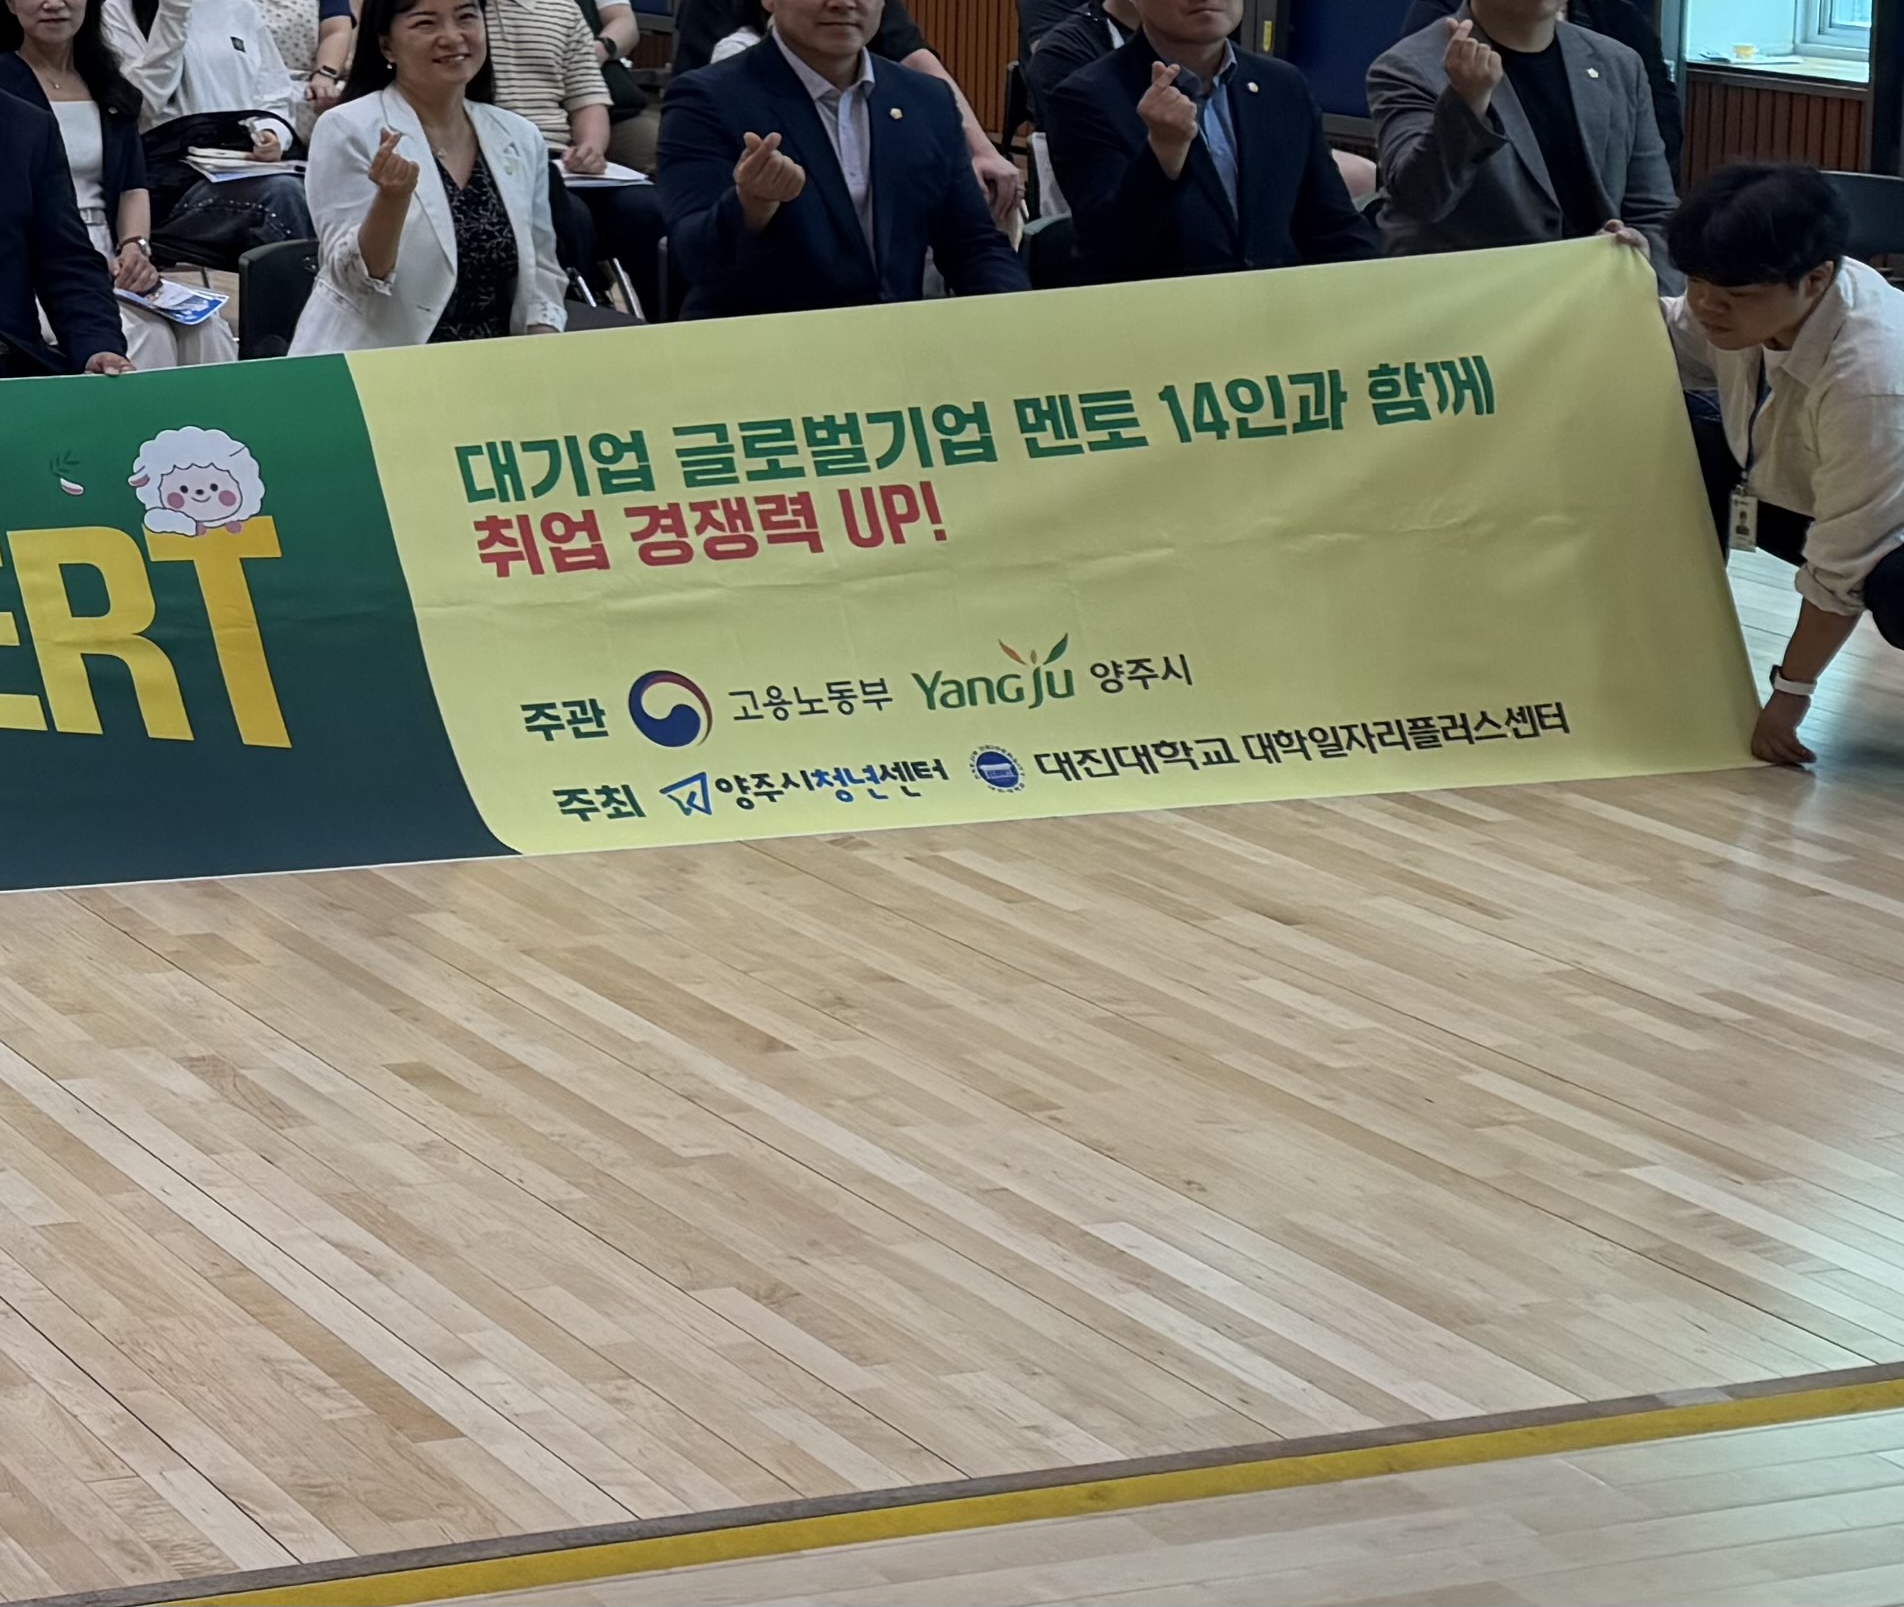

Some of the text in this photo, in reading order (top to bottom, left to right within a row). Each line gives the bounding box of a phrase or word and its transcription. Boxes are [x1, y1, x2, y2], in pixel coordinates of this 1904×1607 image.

[455, 354, 1497, 504] 대기업 글로벌기업 멘토 14인과 함께
[475, 482, 945, 578] 취업 경쟁력 UP!
[521, 698, 608, 742] 주관
[728, 677, 894, 722] 고용노동부
[1089, 653, 1194, 694] 양주시
[552, 783, 646, 822] 주최
[714, 758, 949, 810] 양주시청년센터
[1033, 737, 1240, 782] 대진대학교
[1241, 701, 1571, 761] 대학일자리플러스센터
